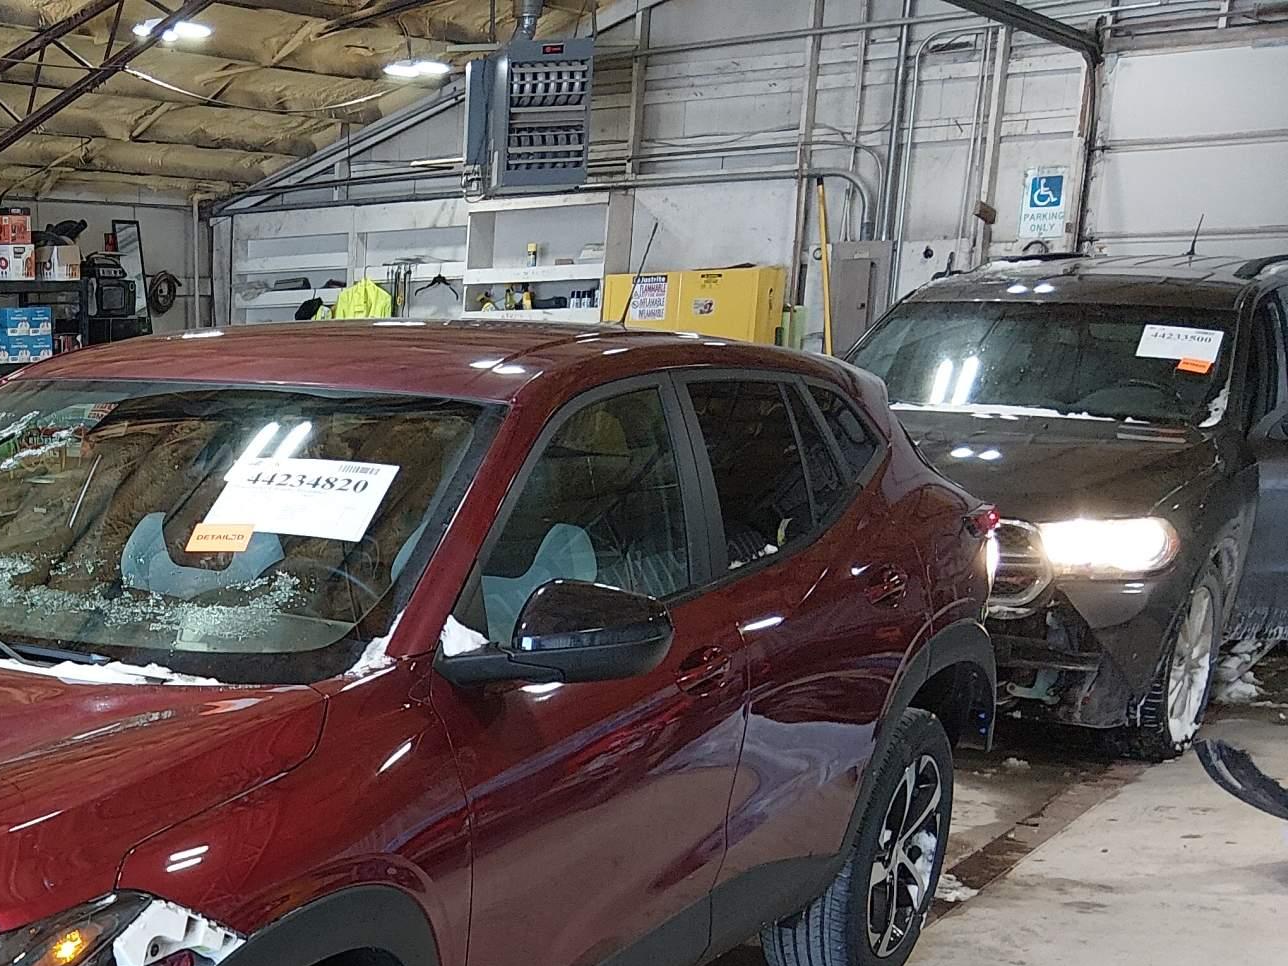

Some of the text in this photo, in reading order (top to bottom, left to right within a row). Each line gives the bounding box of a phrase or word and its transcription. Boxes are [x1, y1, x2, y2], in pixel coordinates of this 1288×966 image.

[1024, 212, 1065, 221] PARKING
[1030, 224, 1055, 232] ONLY
[248, 472, 369, 493] 44234820
